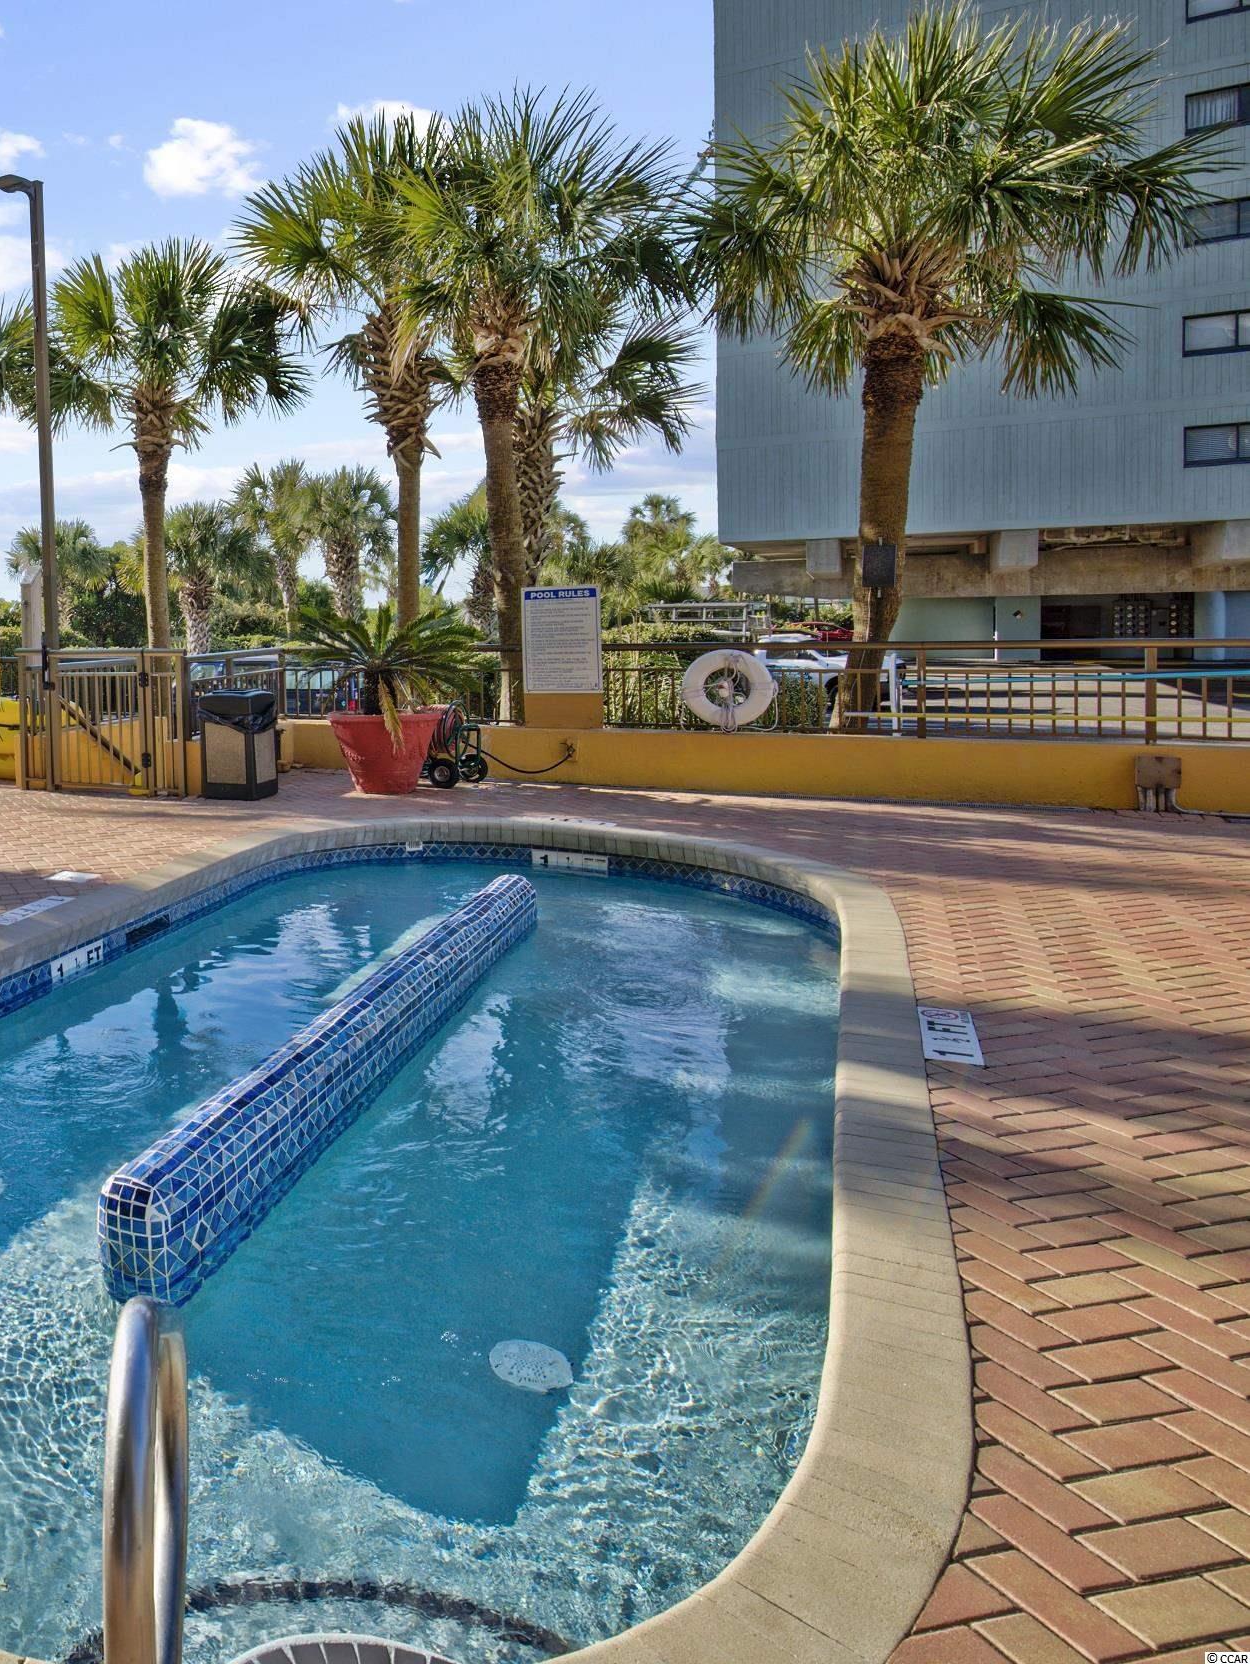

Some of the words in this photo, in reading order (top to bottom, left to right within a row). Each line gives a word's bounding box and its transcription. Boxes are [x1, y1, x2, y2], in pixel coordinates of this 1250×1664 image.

[530, 591, 556, 599] POOL
[558, 590, 590, 598] RULES
[57, 963, 64, 978] 1
[87, 945, 102, 965] FT
[927, 1020, 968, 1035] FT
